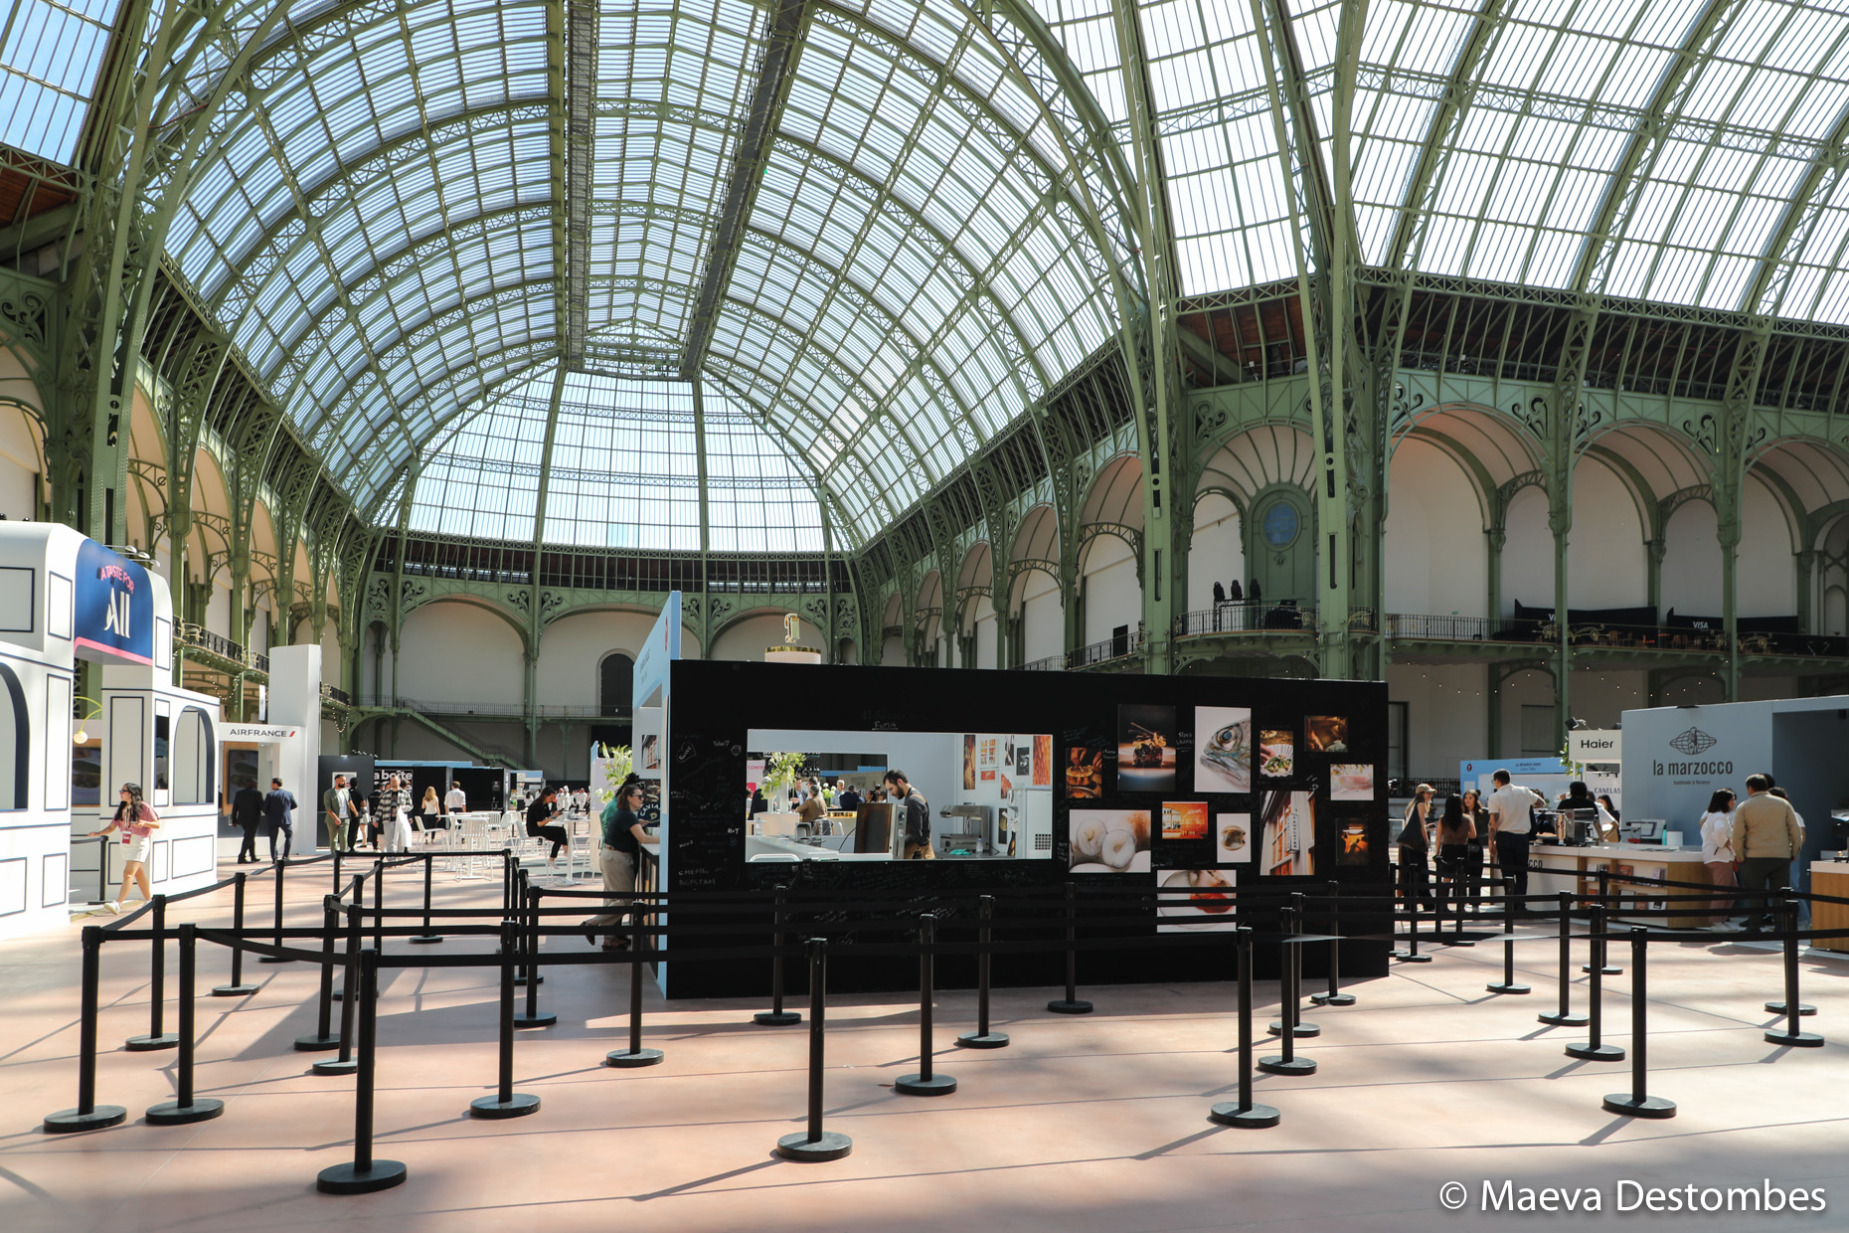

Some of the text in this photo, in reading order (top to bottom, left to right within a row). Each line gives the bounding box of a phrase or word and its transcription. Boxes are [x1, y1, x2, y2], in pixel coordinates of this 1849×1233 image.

[101, 565, 134, 594] A TASTE FOR
[1692, 620, 1709, 629] VISA
[1580, 739, 1614, 749] Haier
[1653, 759, 1733, 775] la marzocco
[640, 803, 660, 817] CAVIA
